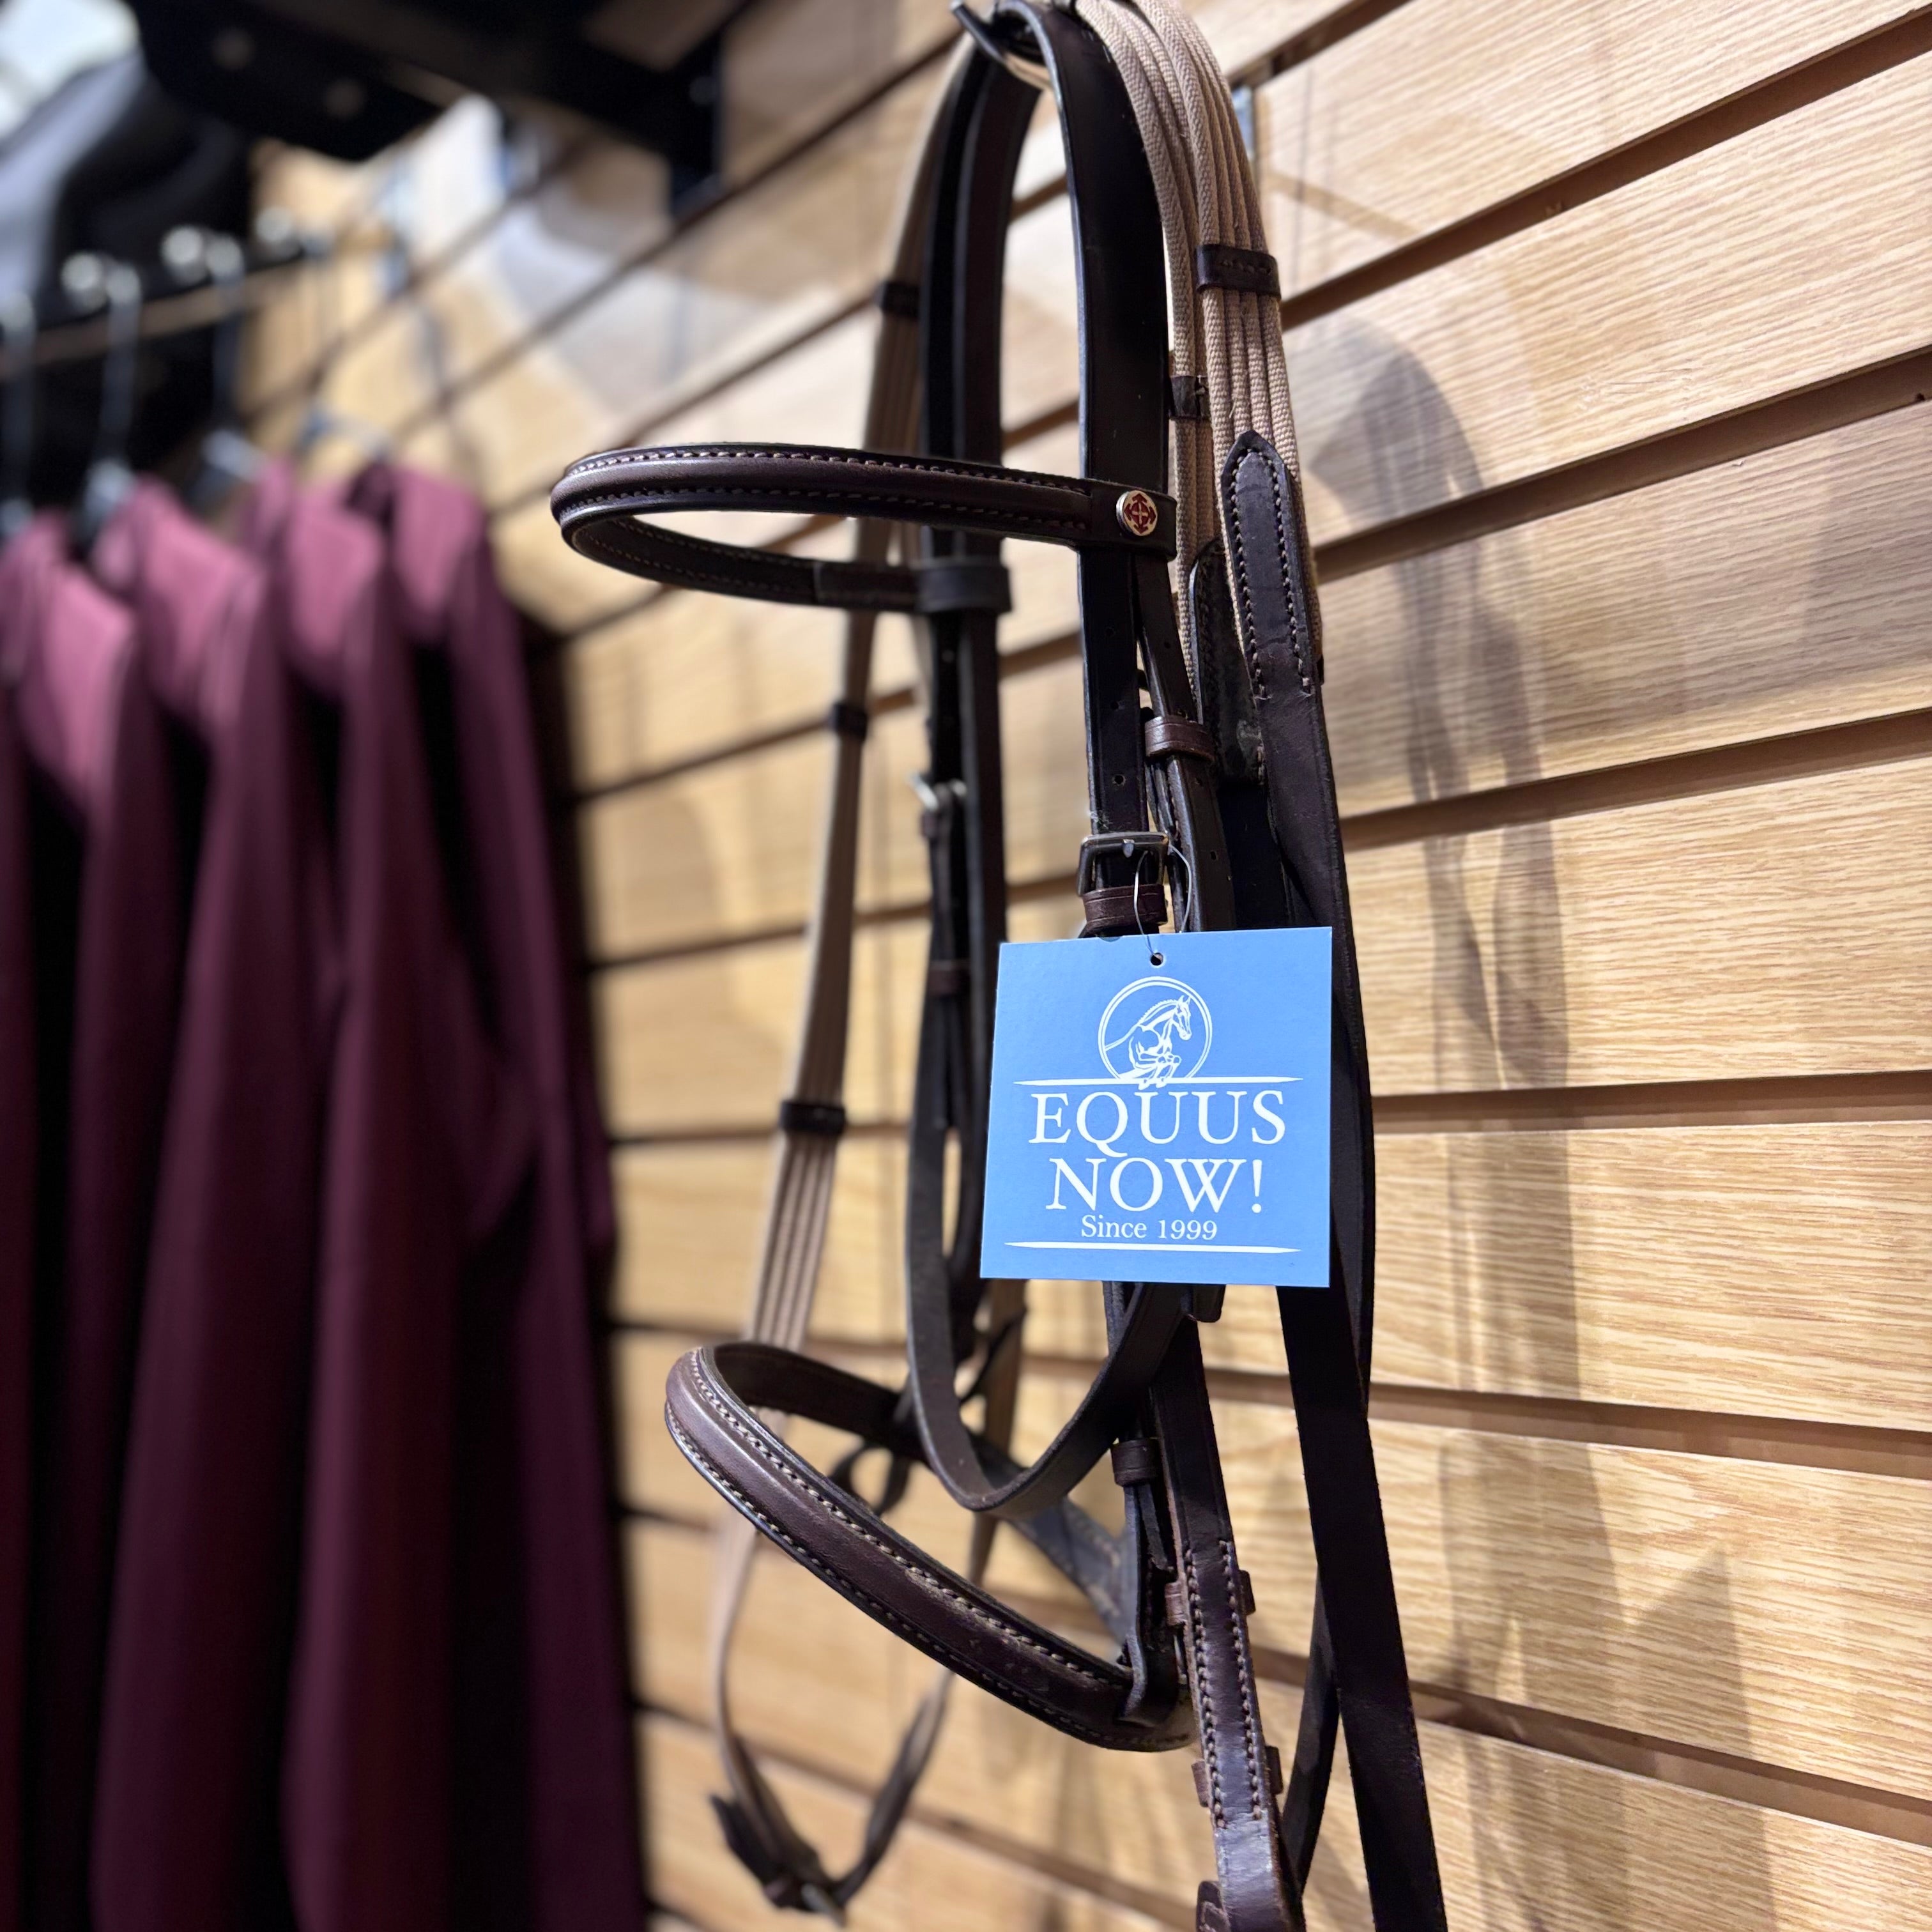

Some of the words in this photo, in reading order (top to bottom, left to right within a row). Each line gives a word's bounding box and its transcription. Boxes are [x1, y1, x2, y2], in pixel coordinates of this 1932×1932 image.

[1028, 1090, 1286, 1158] EQUUS
[1045, 1157, 1263, 1213] NOW!
[1080, 1215, 1147, 1239] Since
[1157, 1219, 1218, 1241] 1999
